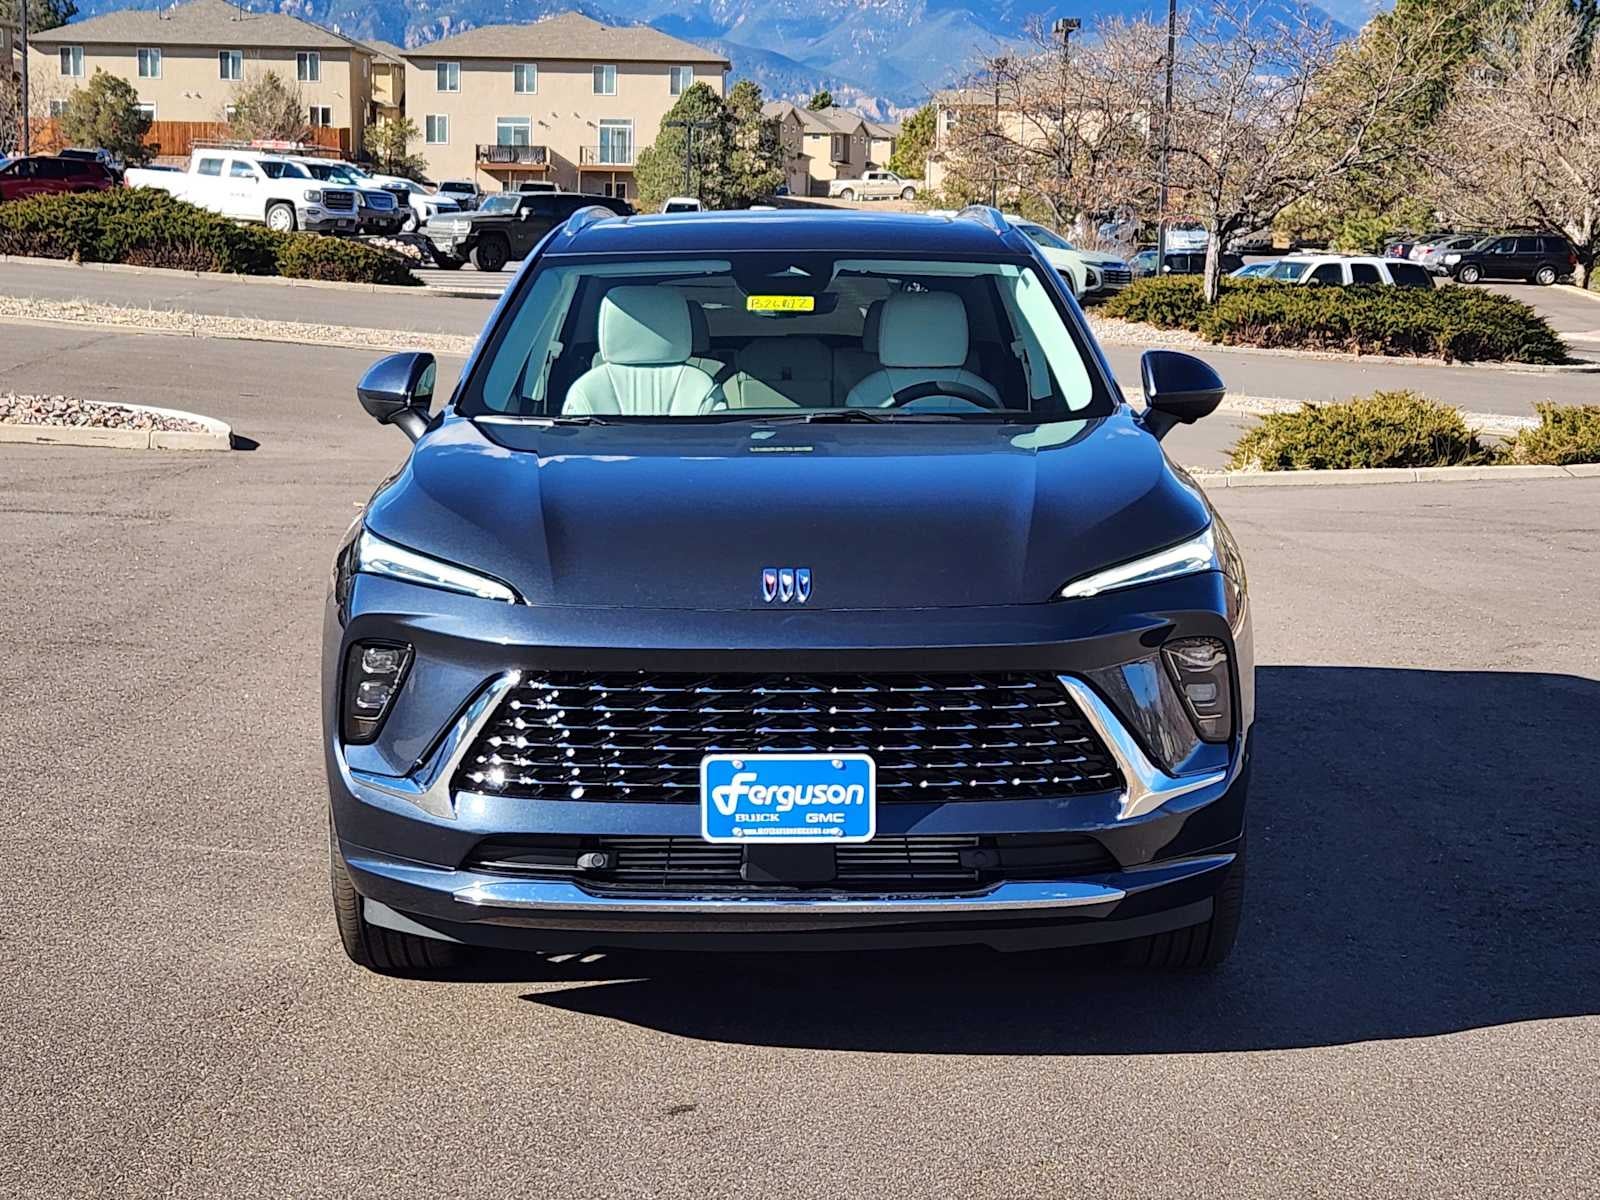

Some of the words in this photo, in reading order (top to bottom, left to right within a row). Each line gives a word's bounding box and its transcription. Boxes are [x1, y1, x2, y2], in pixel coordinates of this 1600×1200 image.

[712, 773, 865, 815] Ferguson
[735, 813, 780, 823] BUICK
[806, 813, 845, 823] GMC
